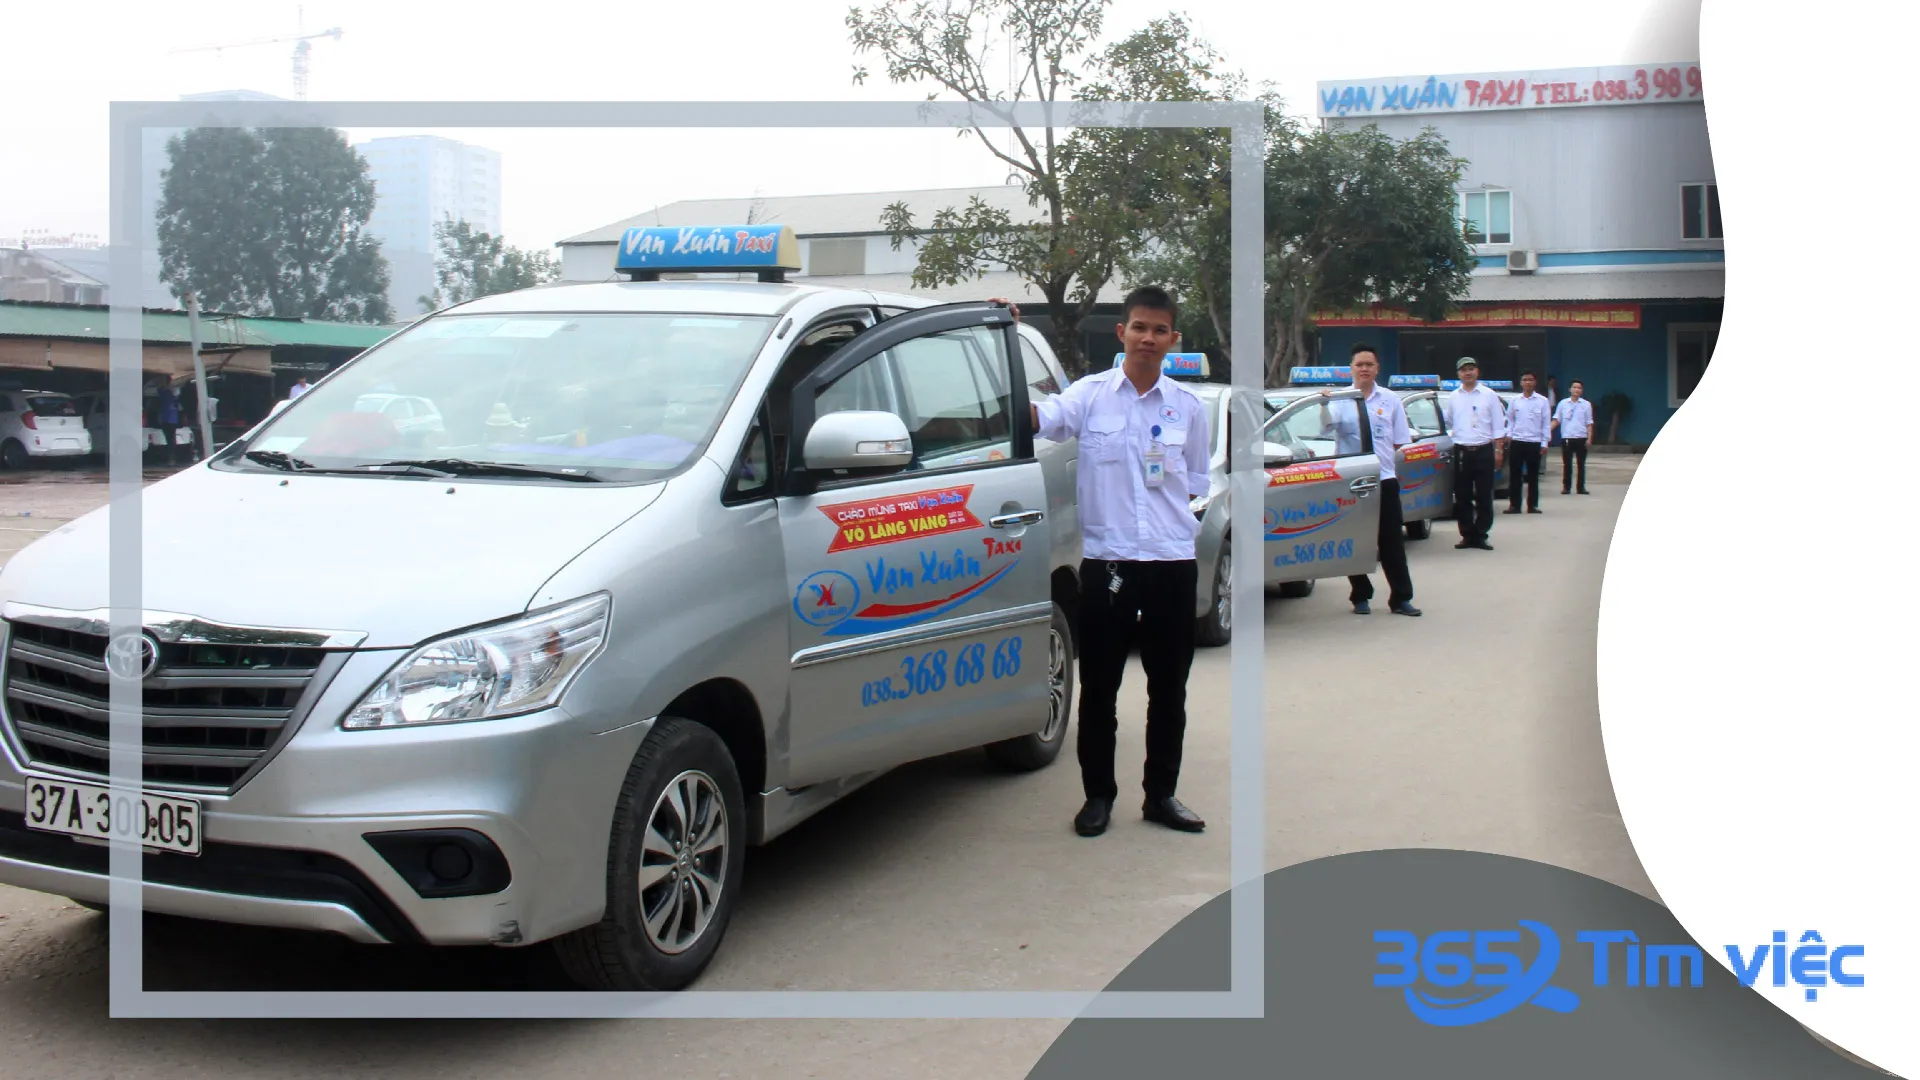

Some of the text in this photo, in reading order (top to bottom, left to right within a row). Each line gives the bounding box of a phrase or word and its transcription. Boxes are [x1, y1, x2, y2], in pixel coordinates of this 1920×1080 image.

[1321, 86, 1375, 116] VẠN
[1382, 76, 1458, 111] XUÂN
[1465, 79, 1526, 107] TAXI
[1531, 82, 1588, 105] TEL:
[626, 227, 776, 262] Vạn Xuân Taxi
[1174, 357, 1199, 370] Taxi
[898, 500, 918, 511] TAXI
[866, 537, 1022, 595] Vạn Xuân Taxi
[954, 643, 986, 687] 68
[992, 636, 1023, 680] 68
